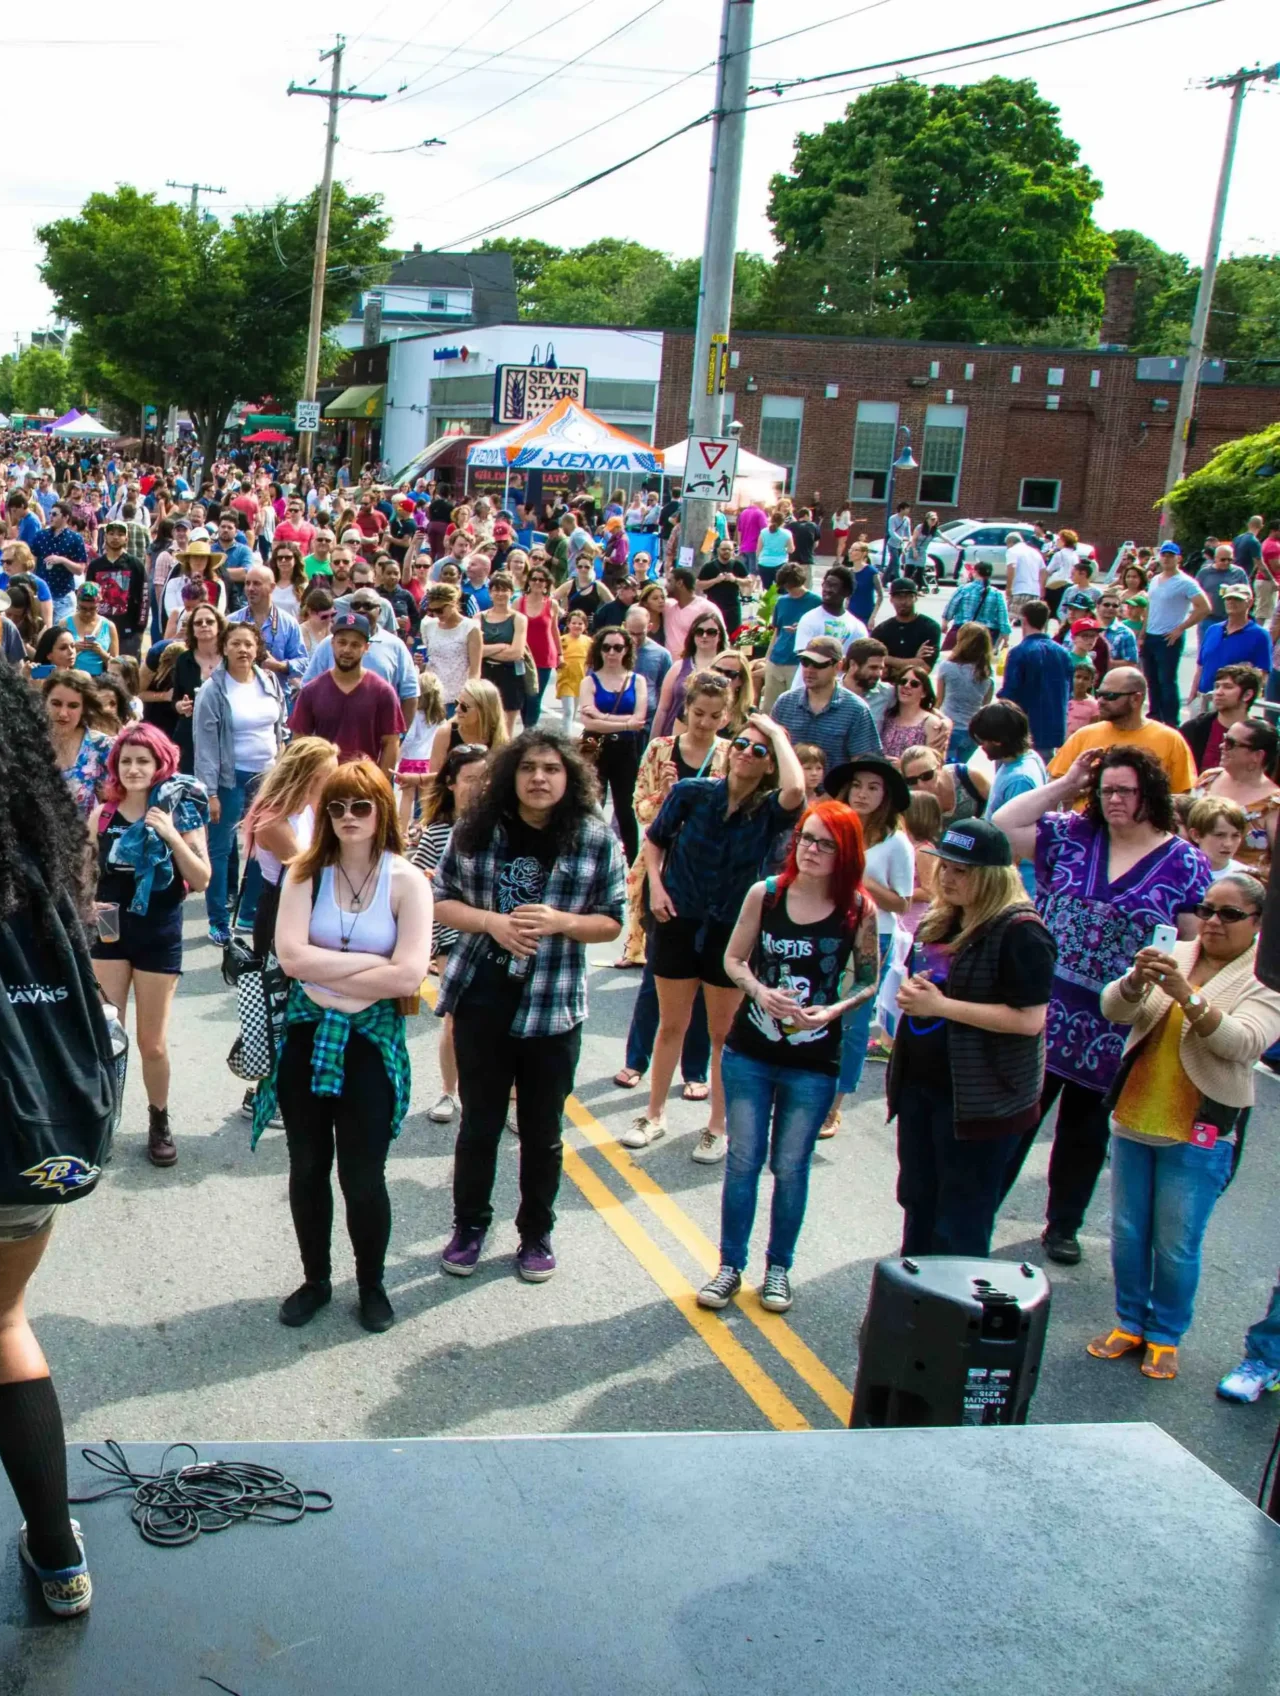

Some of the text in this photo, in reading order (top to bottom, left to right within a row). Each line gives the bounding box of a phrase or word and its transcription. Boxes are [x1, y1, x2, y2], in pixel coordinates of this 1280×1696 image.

[528, 370, 581, 386] SEVEN
[528, 386, 579, 400] STARS
[298, 416, 317, 428] 25
[473, 448, 499, 465] HENNA
[541, 451, 631, 471] HENNA
